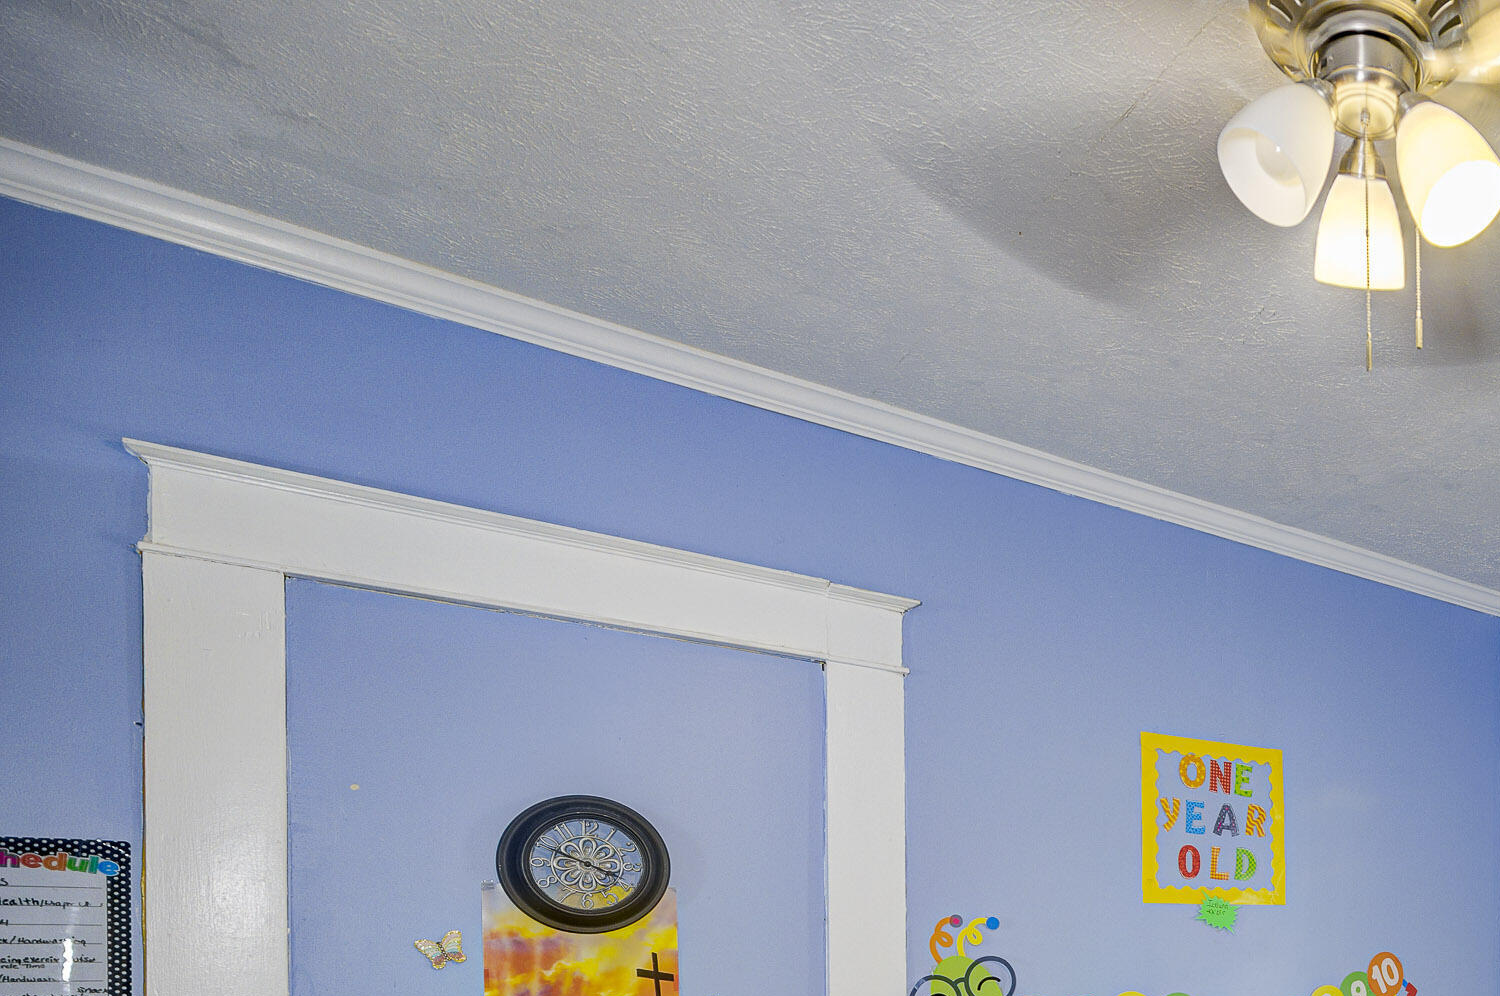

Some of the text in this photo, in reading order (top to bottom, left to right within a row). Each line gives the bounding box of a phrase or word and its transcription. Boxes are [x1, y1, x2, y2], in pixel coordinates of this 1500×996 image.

[1178, 754, 1254, 798] ONE
[580, 819, 599, 837] 12
[1159, 796, 1267, 838] YEAR
[1177, 844, 1258, 881] OLD
[581, 892, 594, 911] 6
[1370, 957, 1400, 993] 10
